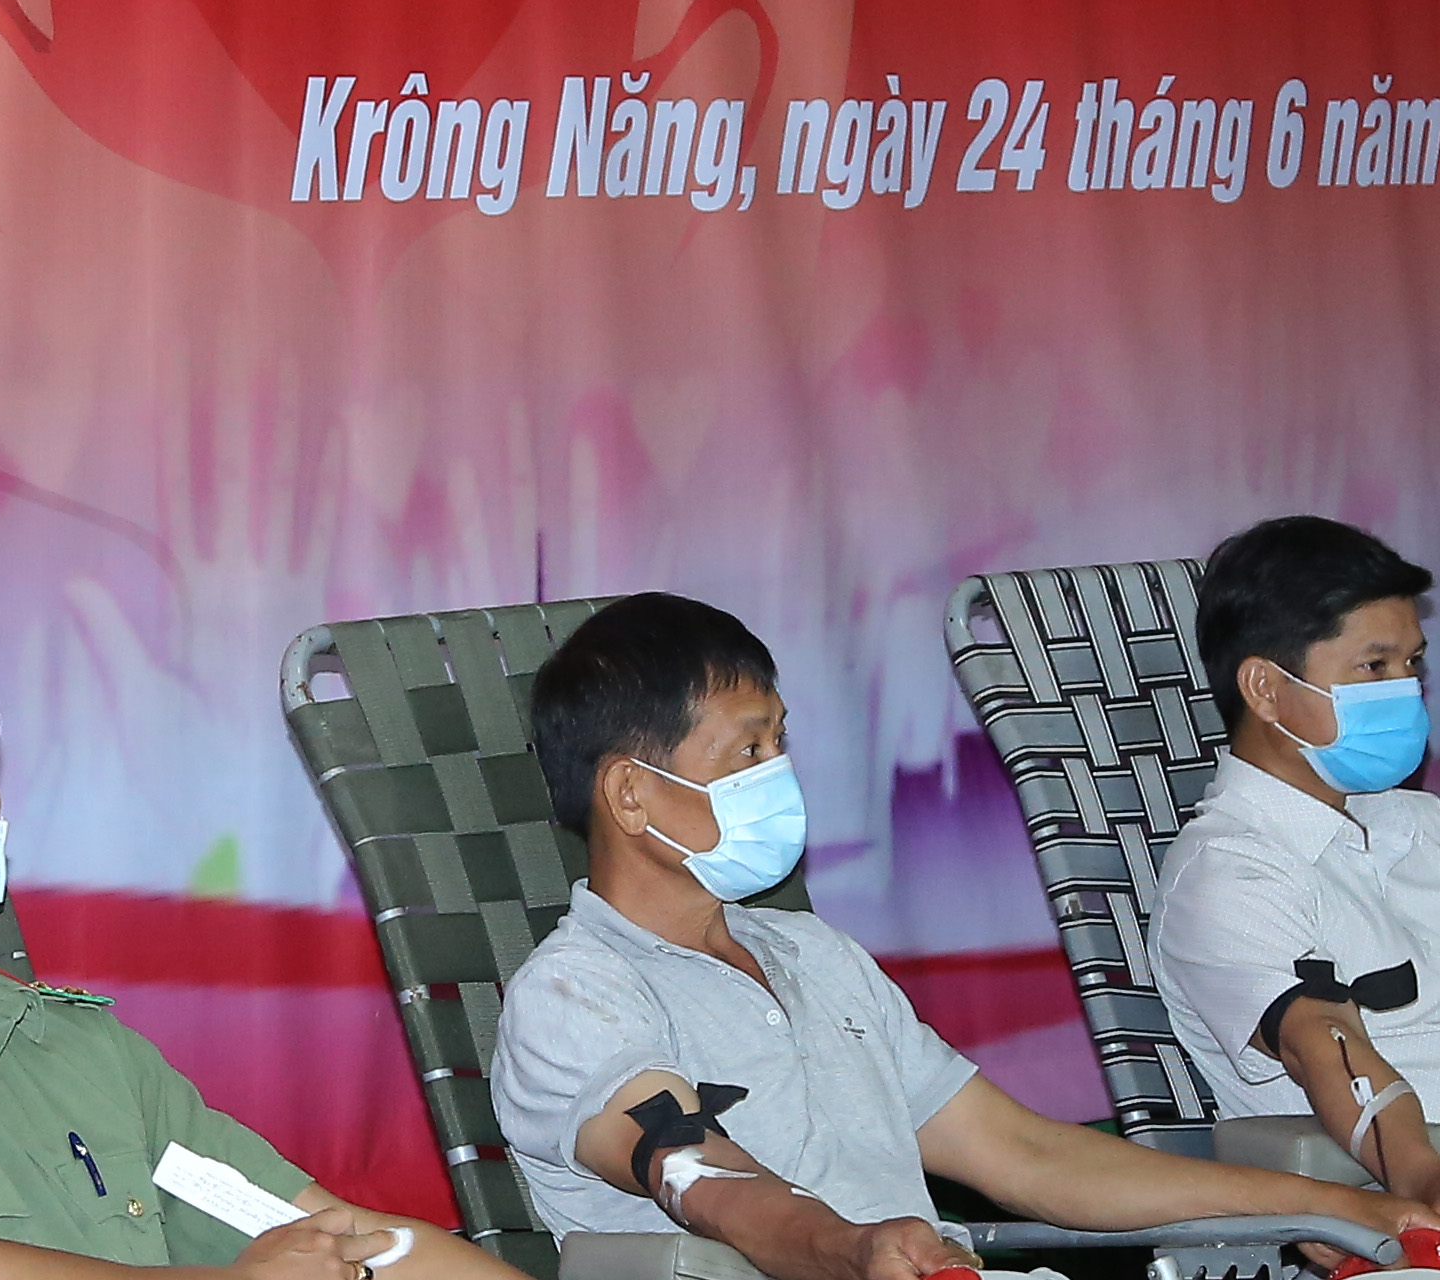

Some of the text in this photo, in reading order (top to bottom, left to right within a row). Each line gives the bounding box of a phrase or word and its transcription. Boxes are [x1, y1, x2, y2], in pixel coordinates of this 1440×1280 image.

[290, 73, 530, 217] Krông
[546, 72, 757, 212] Năng,
[776, 75, 947, 210] ngày
[956, 79, 1050, 193] 24
[1067, 75, 1254, 203] tháng
[1266, 79, 1308, 189] 6
